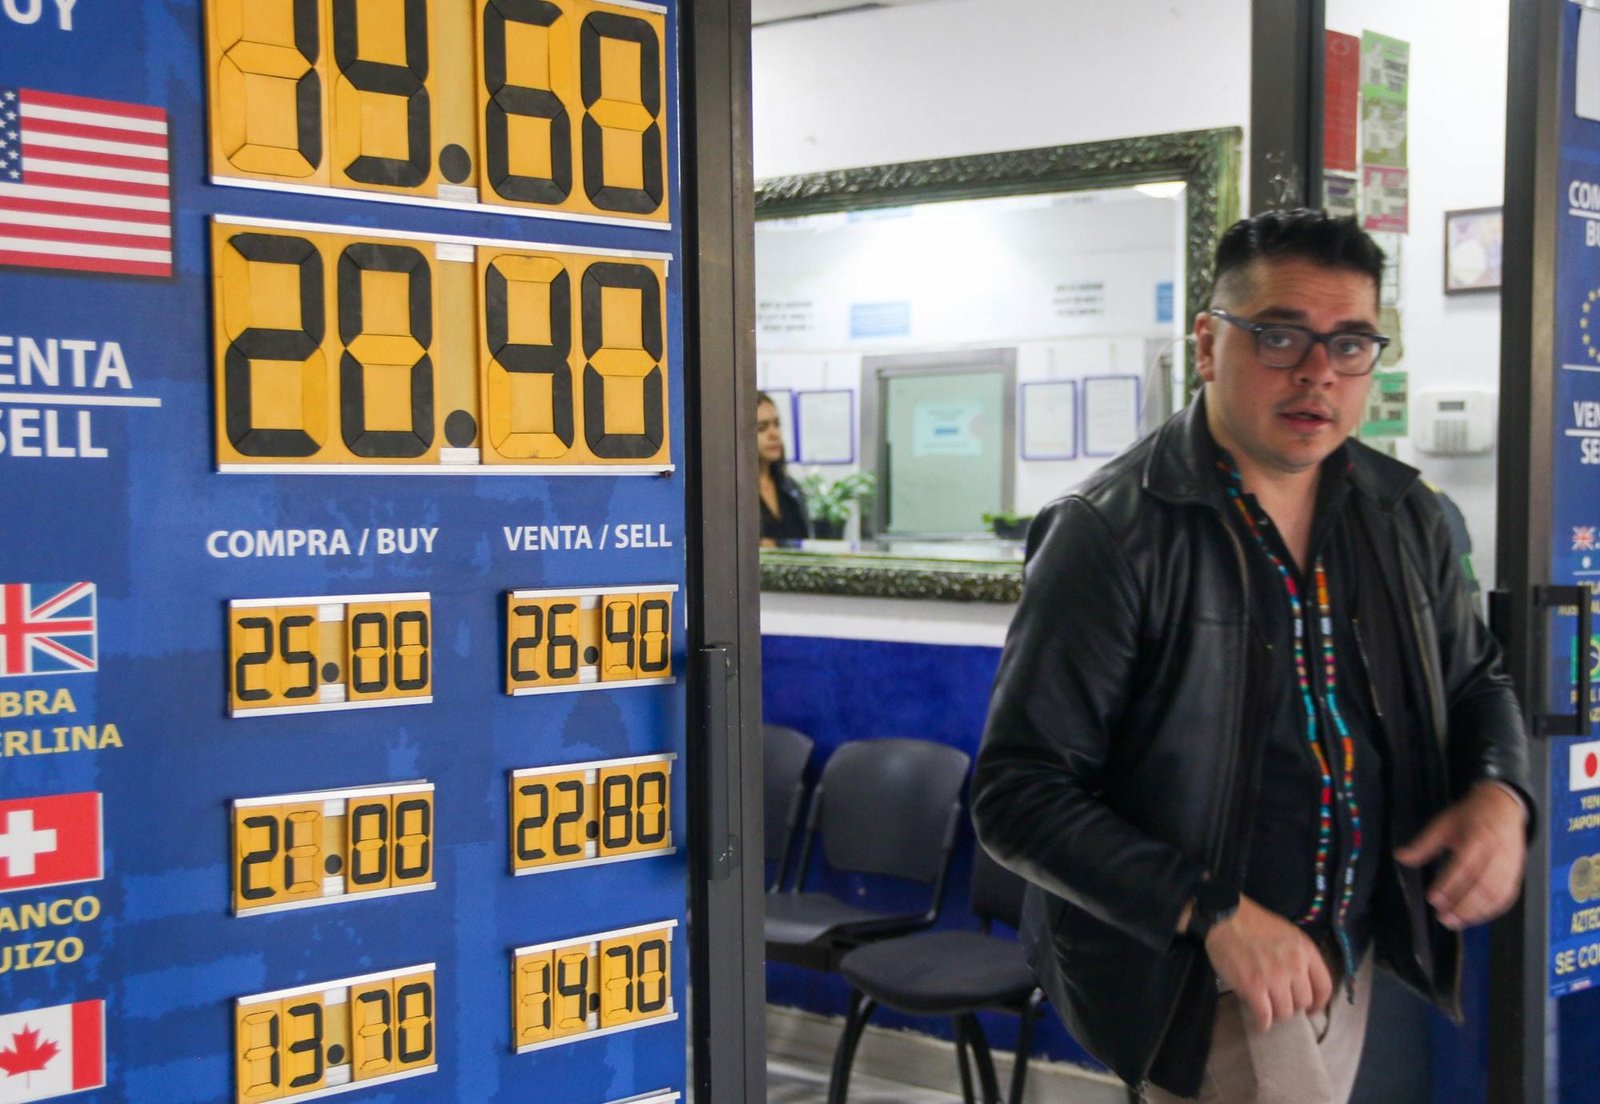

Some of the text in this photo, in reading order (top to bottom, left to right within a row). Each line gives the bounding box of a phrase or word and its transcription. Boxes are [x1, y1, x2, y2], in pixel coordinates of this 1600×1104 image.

[295, 0, 664, 214] 19.60
[224, 232, 665, 458] 20.40
[206, 527, 439, 558] COMPRA / BUY
[503, 524, 672, 551] VENTA / SELL
[236, 611, 429, 701] 25.00
[511, 599, 670, 682] 26.40
[241, 799, 431, 901] 21.00
[517, 771, 666, 861] 22.80
[543, 939, 666, 1030] 14.70
[269, 982, 432, 1089] 13.70
